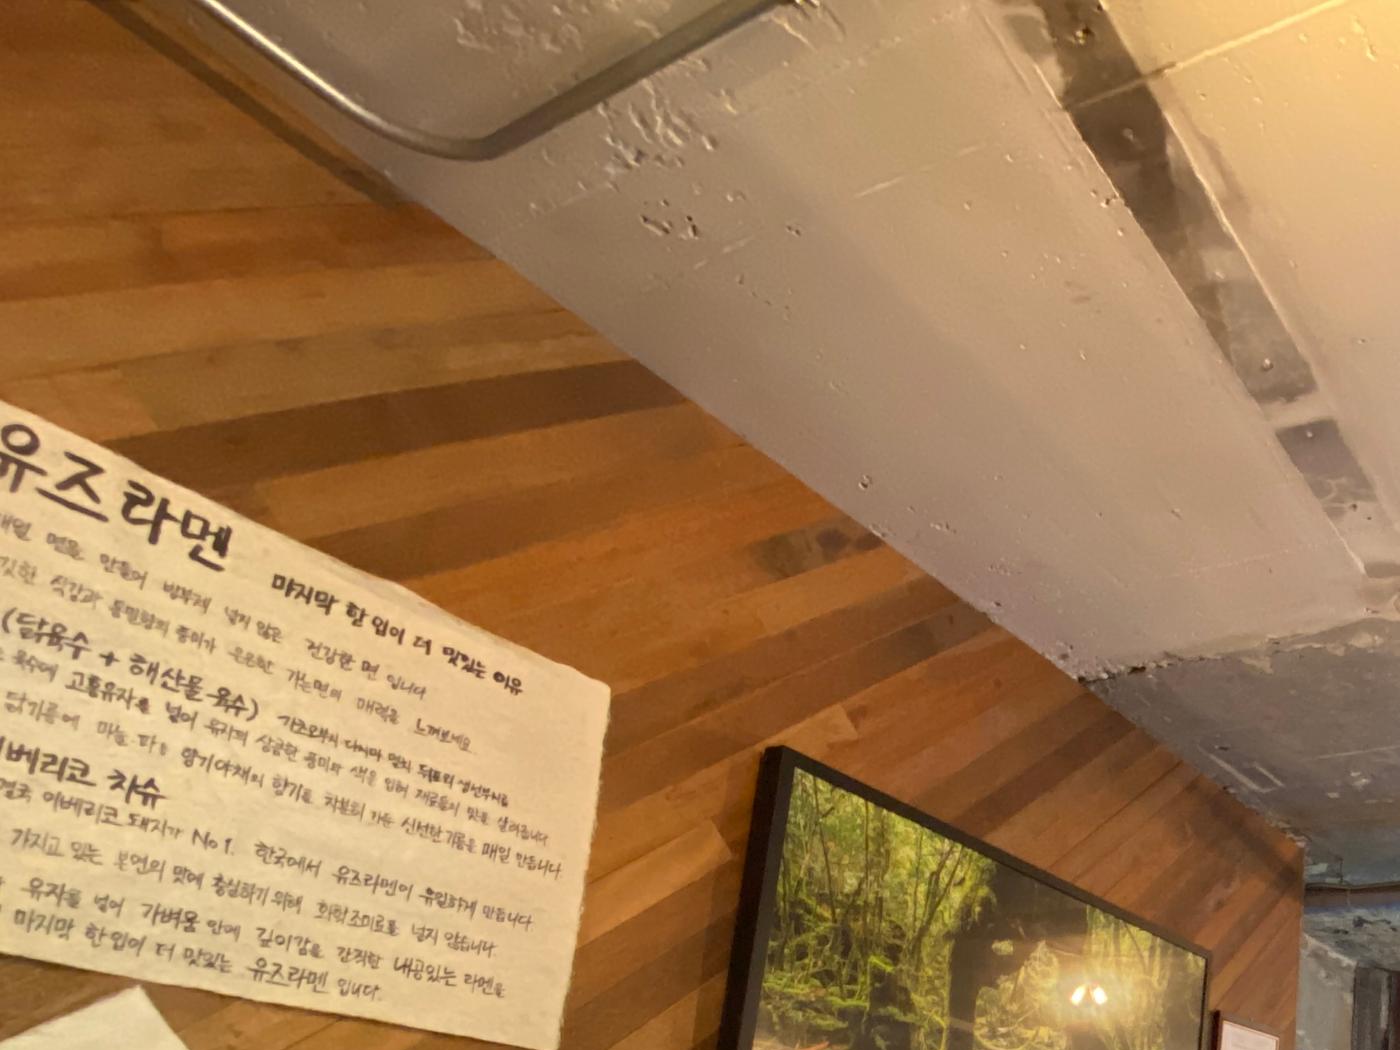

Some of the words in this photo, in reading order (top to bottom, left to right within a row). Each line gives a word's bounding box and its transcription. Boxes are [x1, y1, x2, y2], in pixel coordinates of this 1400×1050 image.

[0, 424, 234, 572] 유즈라멘
[272, 574, 340, 616] 마지막
[412, 636, 432, 655] 더
[442, 646, 487, 680] 맛있는
[493, 670, 523, 696] 이유
[129, 653, 203, 702] 해산물
[206, 687, 259, 722] 육수)
[0, 734, 97, 789] 베리코
[107, 769, 168, 810] 차슈
[11, 827, 65, 857] 가지고
[43, 791, 124, 827] 이베리코
[127, 811, 186, 840] 돼지가
[254, 840, 322, 878] 한국에서
[332, 865, 414, 900] 유즈라멘이
[482, 843, 511, 864] 매일
[13, 908, 76, 941] 마지막
[154, 942, 176, 960] 더
[183, 947, 233, 974] 맛있는
